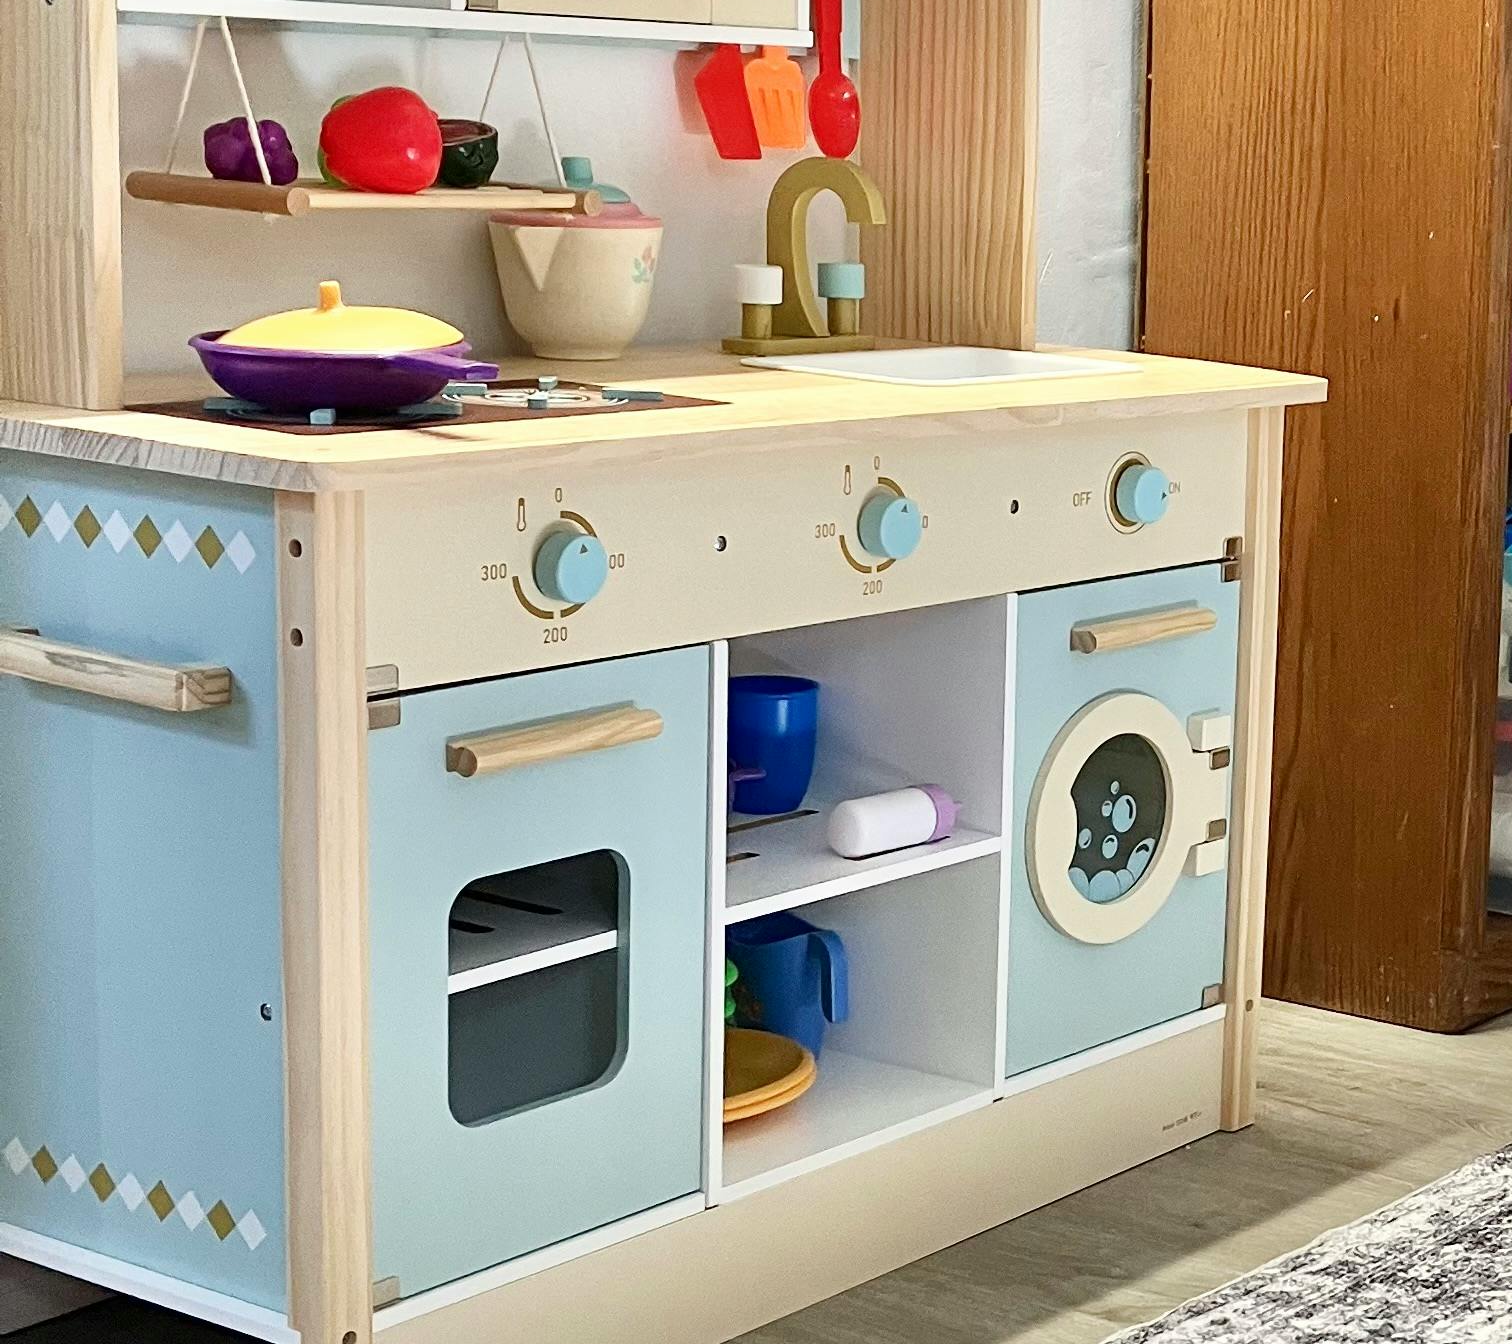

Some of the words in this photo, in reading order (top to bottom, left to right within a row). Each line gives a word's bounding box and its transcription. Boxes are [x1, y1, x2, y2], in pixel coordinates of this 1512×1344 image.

[873, 455, 880, 470] 0
[554, 487, 563, 503] 0
[1168, 481, 1181, 494] ON
[1072, 491, 1093, 507] OFF
[815, 522, 836, 539] 300
[480, 563, 507, 582] 300
[862, 579, 883, 596] 200
[543, 626, 568, 644] 200
